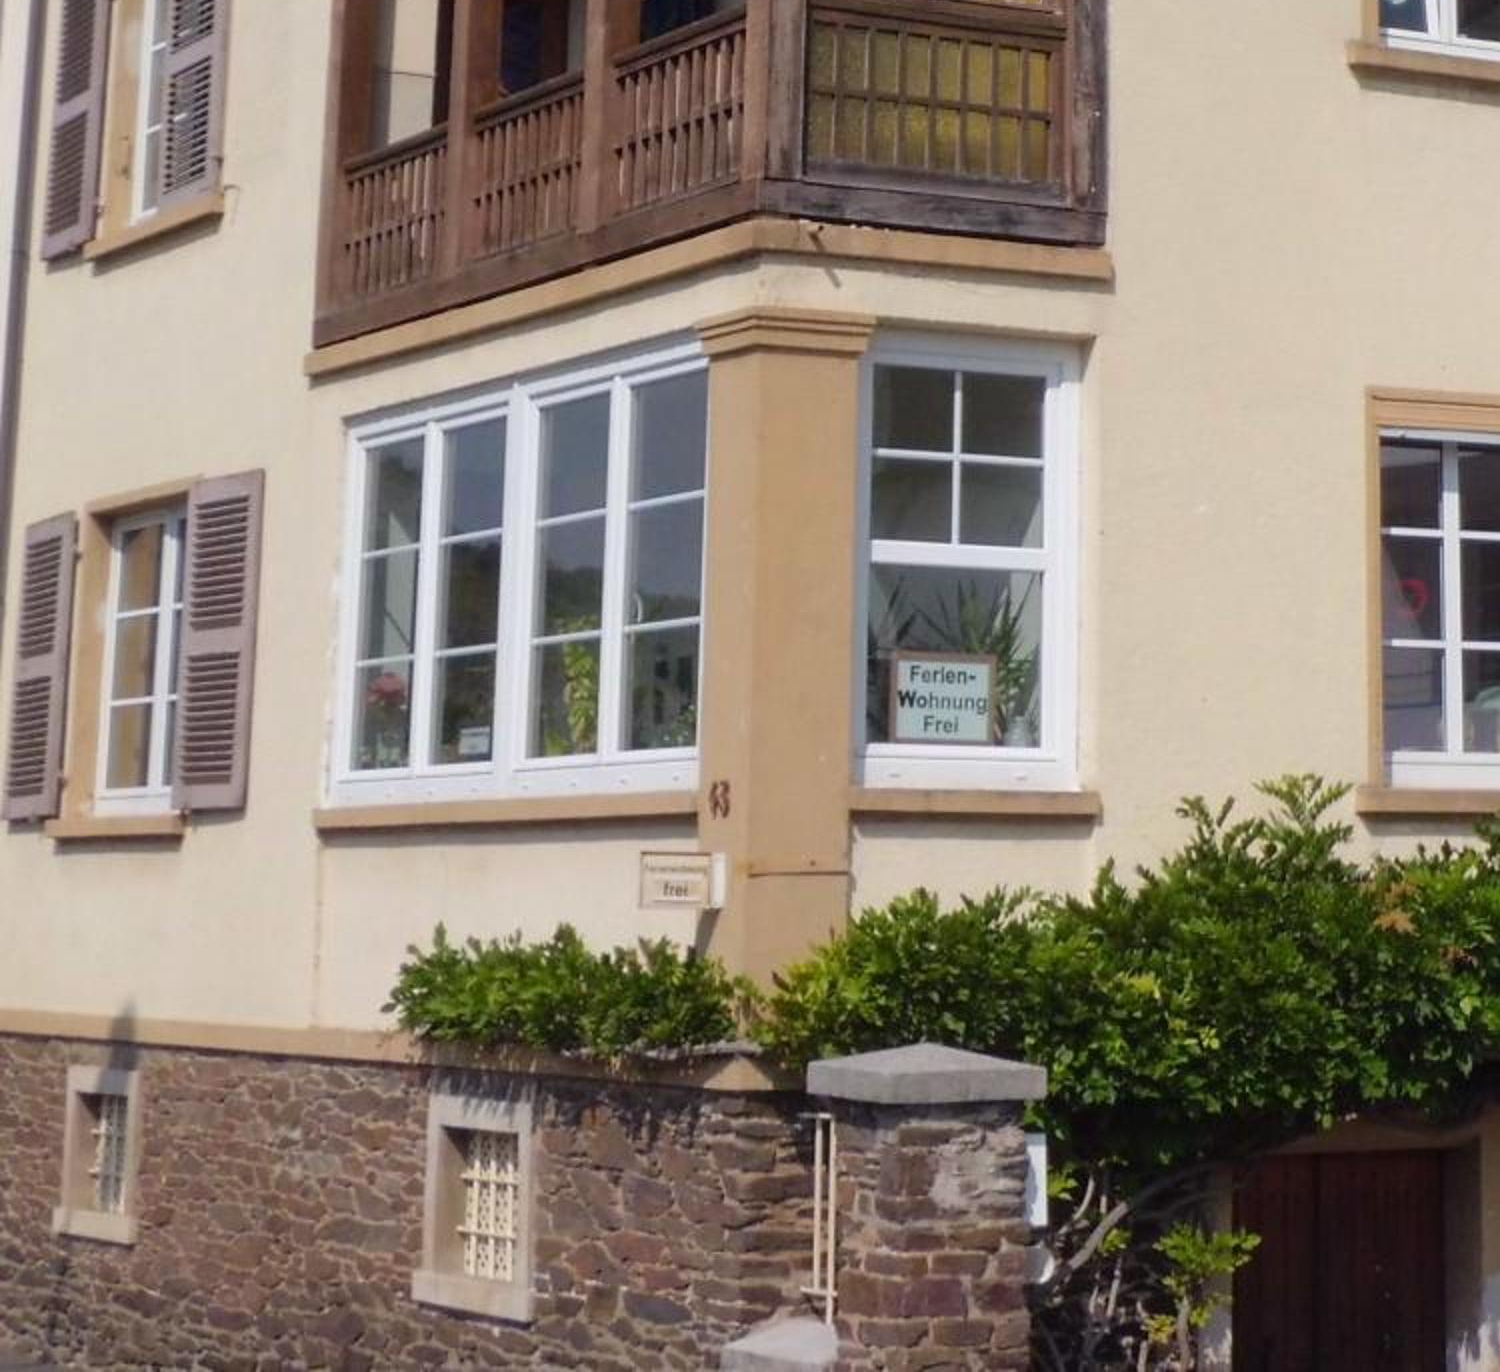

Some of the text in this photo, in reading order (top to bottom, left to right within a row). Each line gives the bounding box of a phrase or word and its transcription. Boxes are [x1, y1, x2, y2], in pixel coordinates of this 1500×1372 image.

[910, 665, 976, 684] Ferien-
[897, 690, 987, 715] Wohnung
[923, 715, 959, 733] Frei
